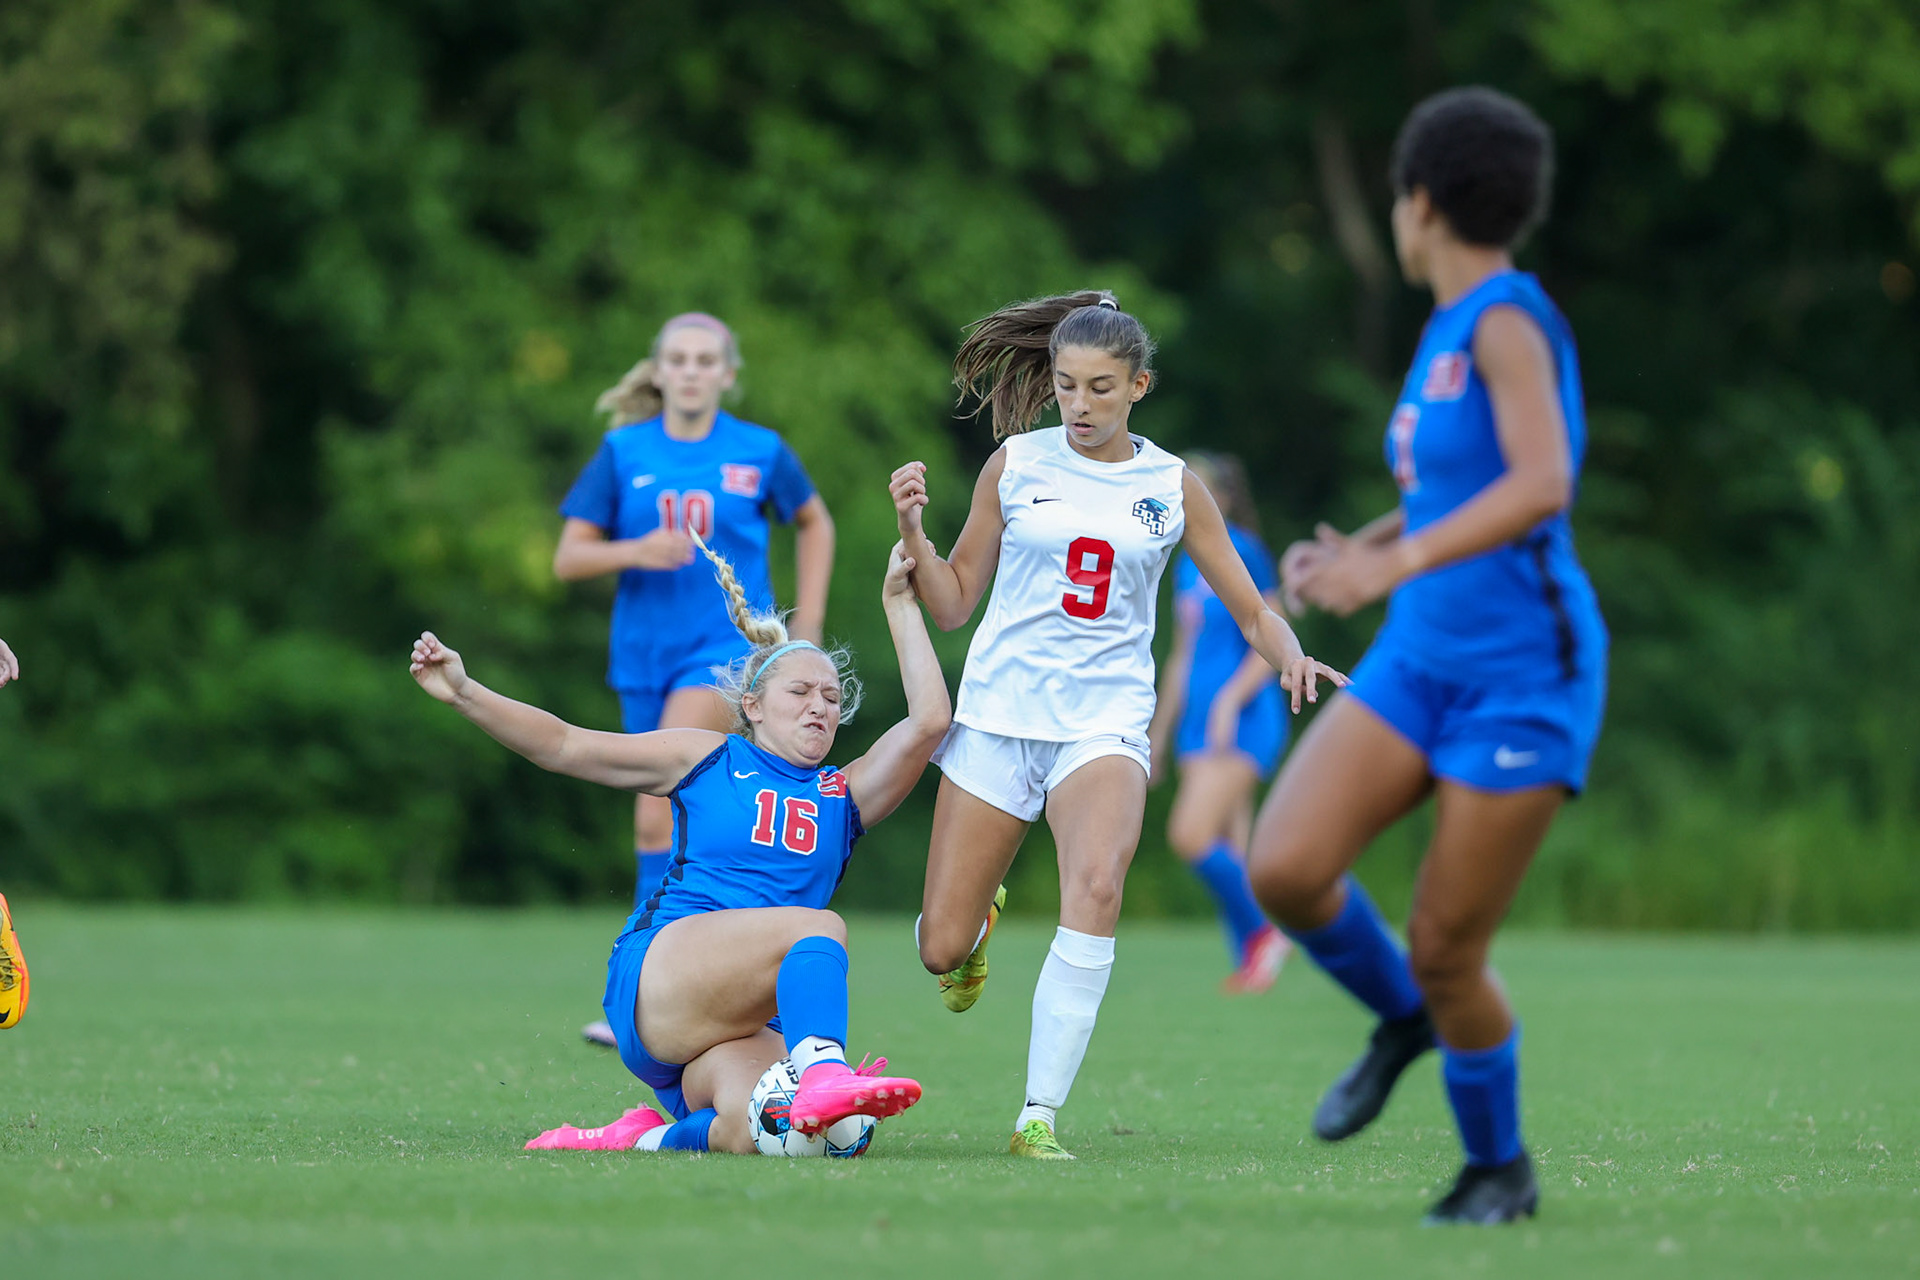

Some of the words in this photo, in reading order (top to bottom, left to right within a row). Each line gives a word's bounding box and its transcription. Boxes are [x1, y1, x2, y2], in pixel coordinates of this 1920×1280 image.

[656, 489, 715, 543] 10
[1132, 499, 1166, 537] SBA
[1061, 536, 1115, 620] 9
[751, 788, 818, 856] 16
